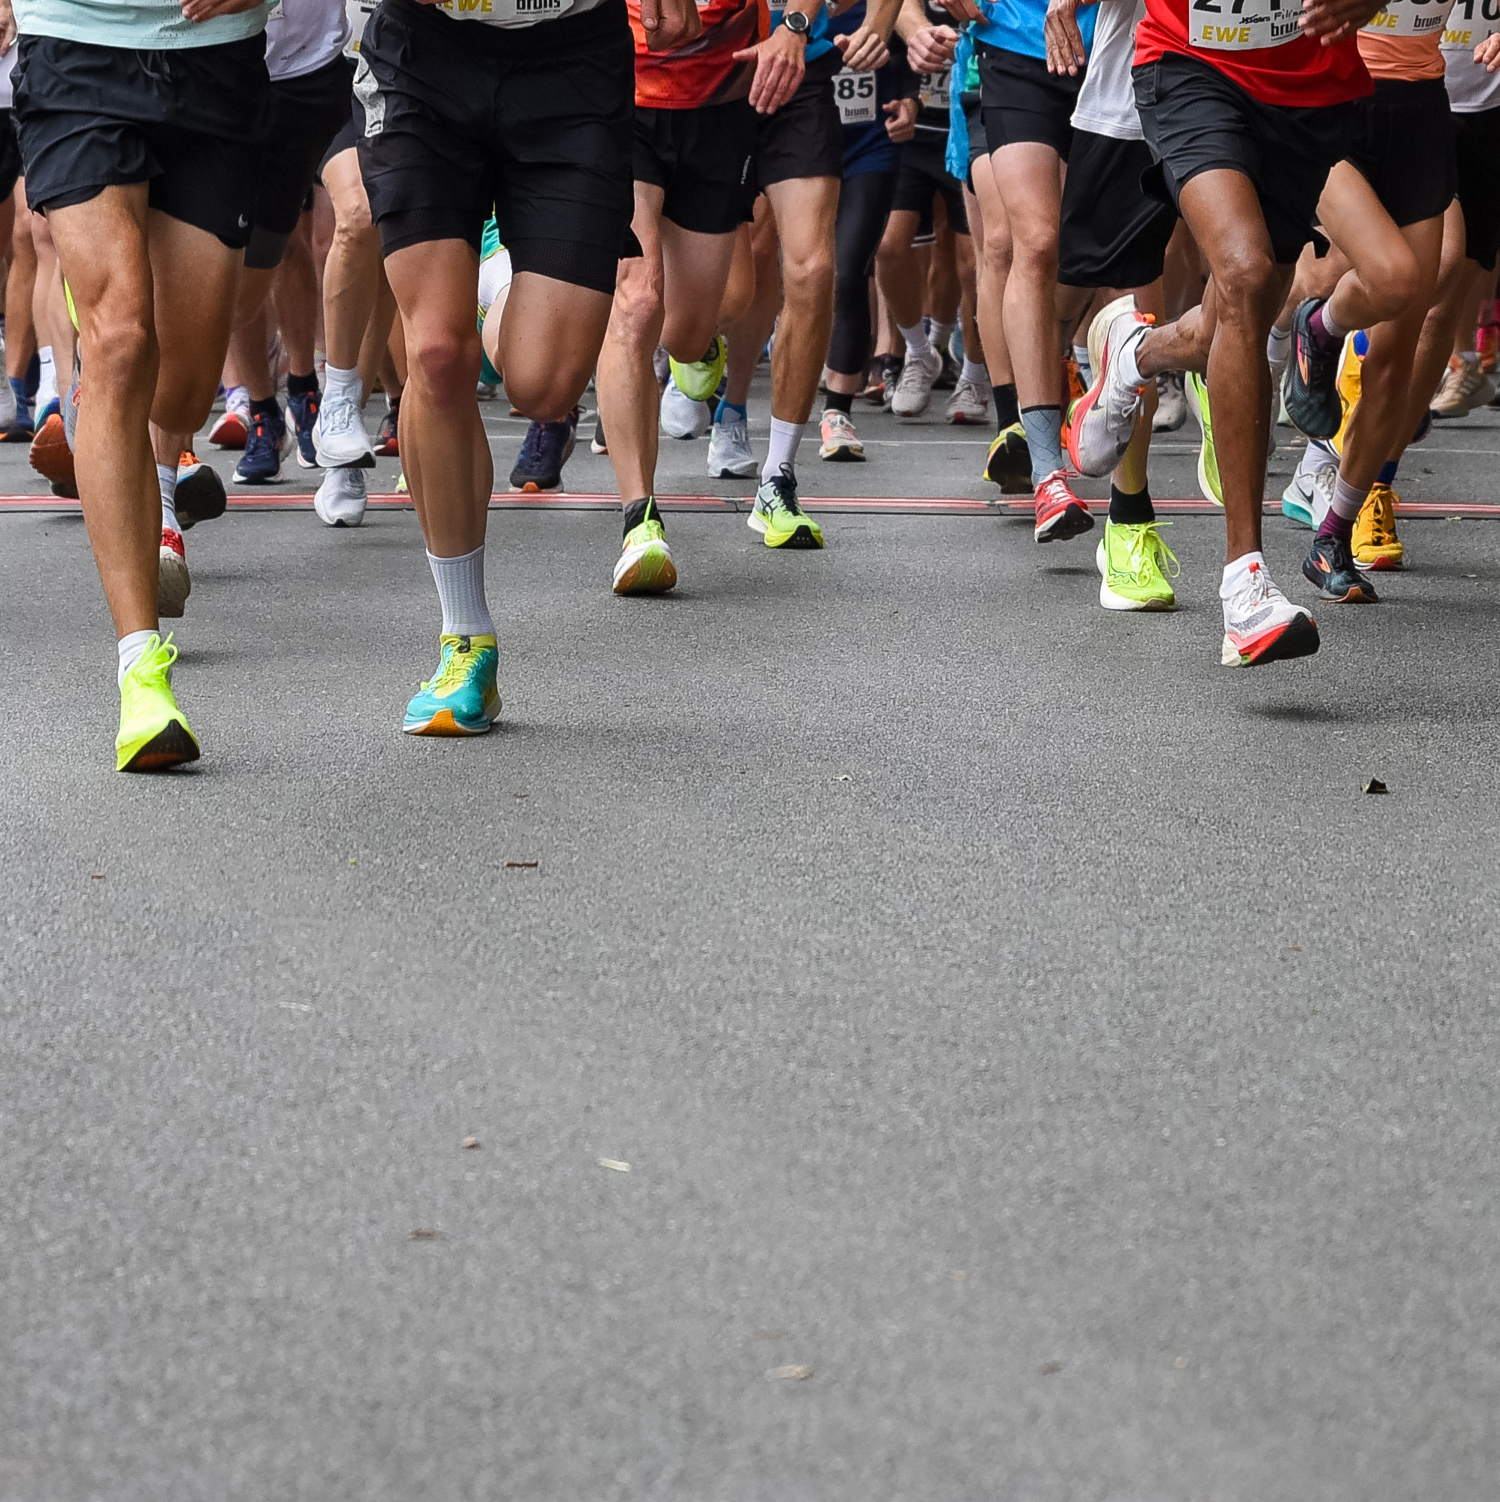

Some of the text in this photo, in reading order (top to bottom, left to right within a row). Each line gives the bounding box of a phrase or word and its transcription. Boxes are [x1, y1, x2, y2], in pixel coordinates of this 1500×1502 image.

[1368, 11, 1444, 29] WE bruns
[1202, 24, 1251, 43] EWE
[1443, 30, 1472, 45] WE
[836, 76, 874, 100] 85
